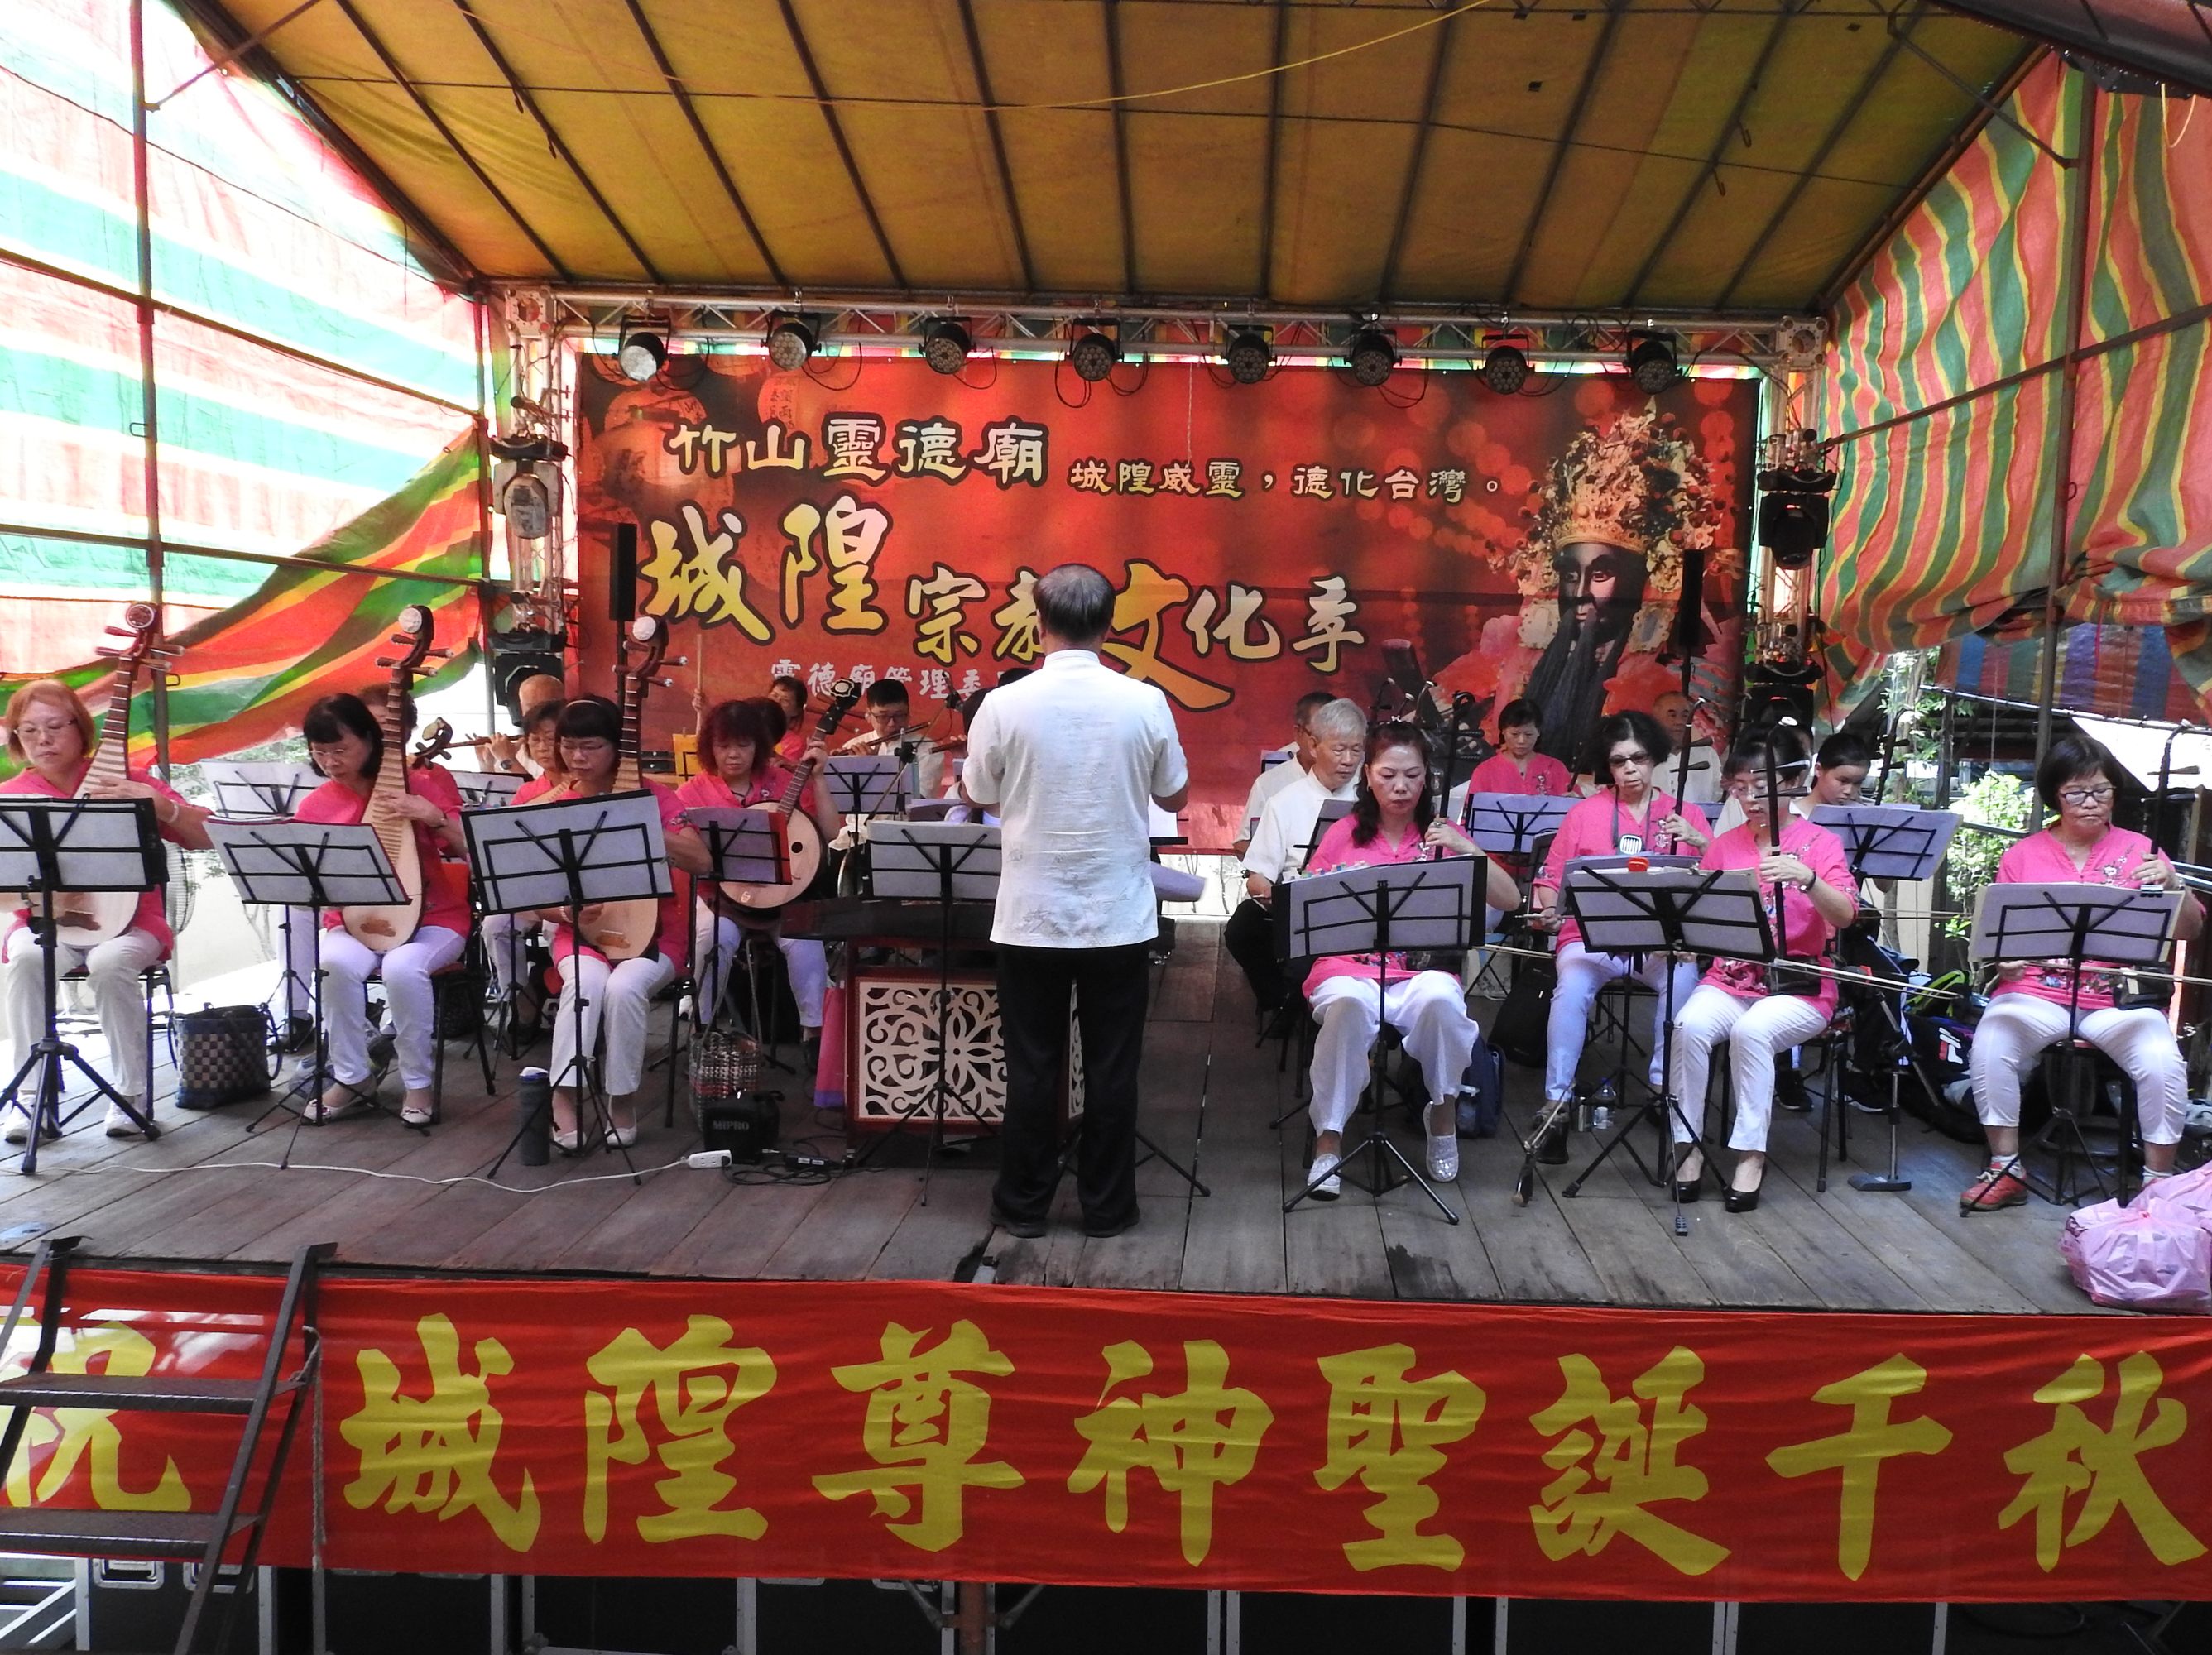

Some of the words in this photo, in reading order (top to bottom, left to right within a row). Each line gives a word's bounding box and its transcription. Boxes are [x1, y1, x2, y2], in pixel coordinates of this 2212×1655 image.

[668, 417, 1045, 483] 竹山靈德廟
[713, 1120, 749, 1130] MIPRO
